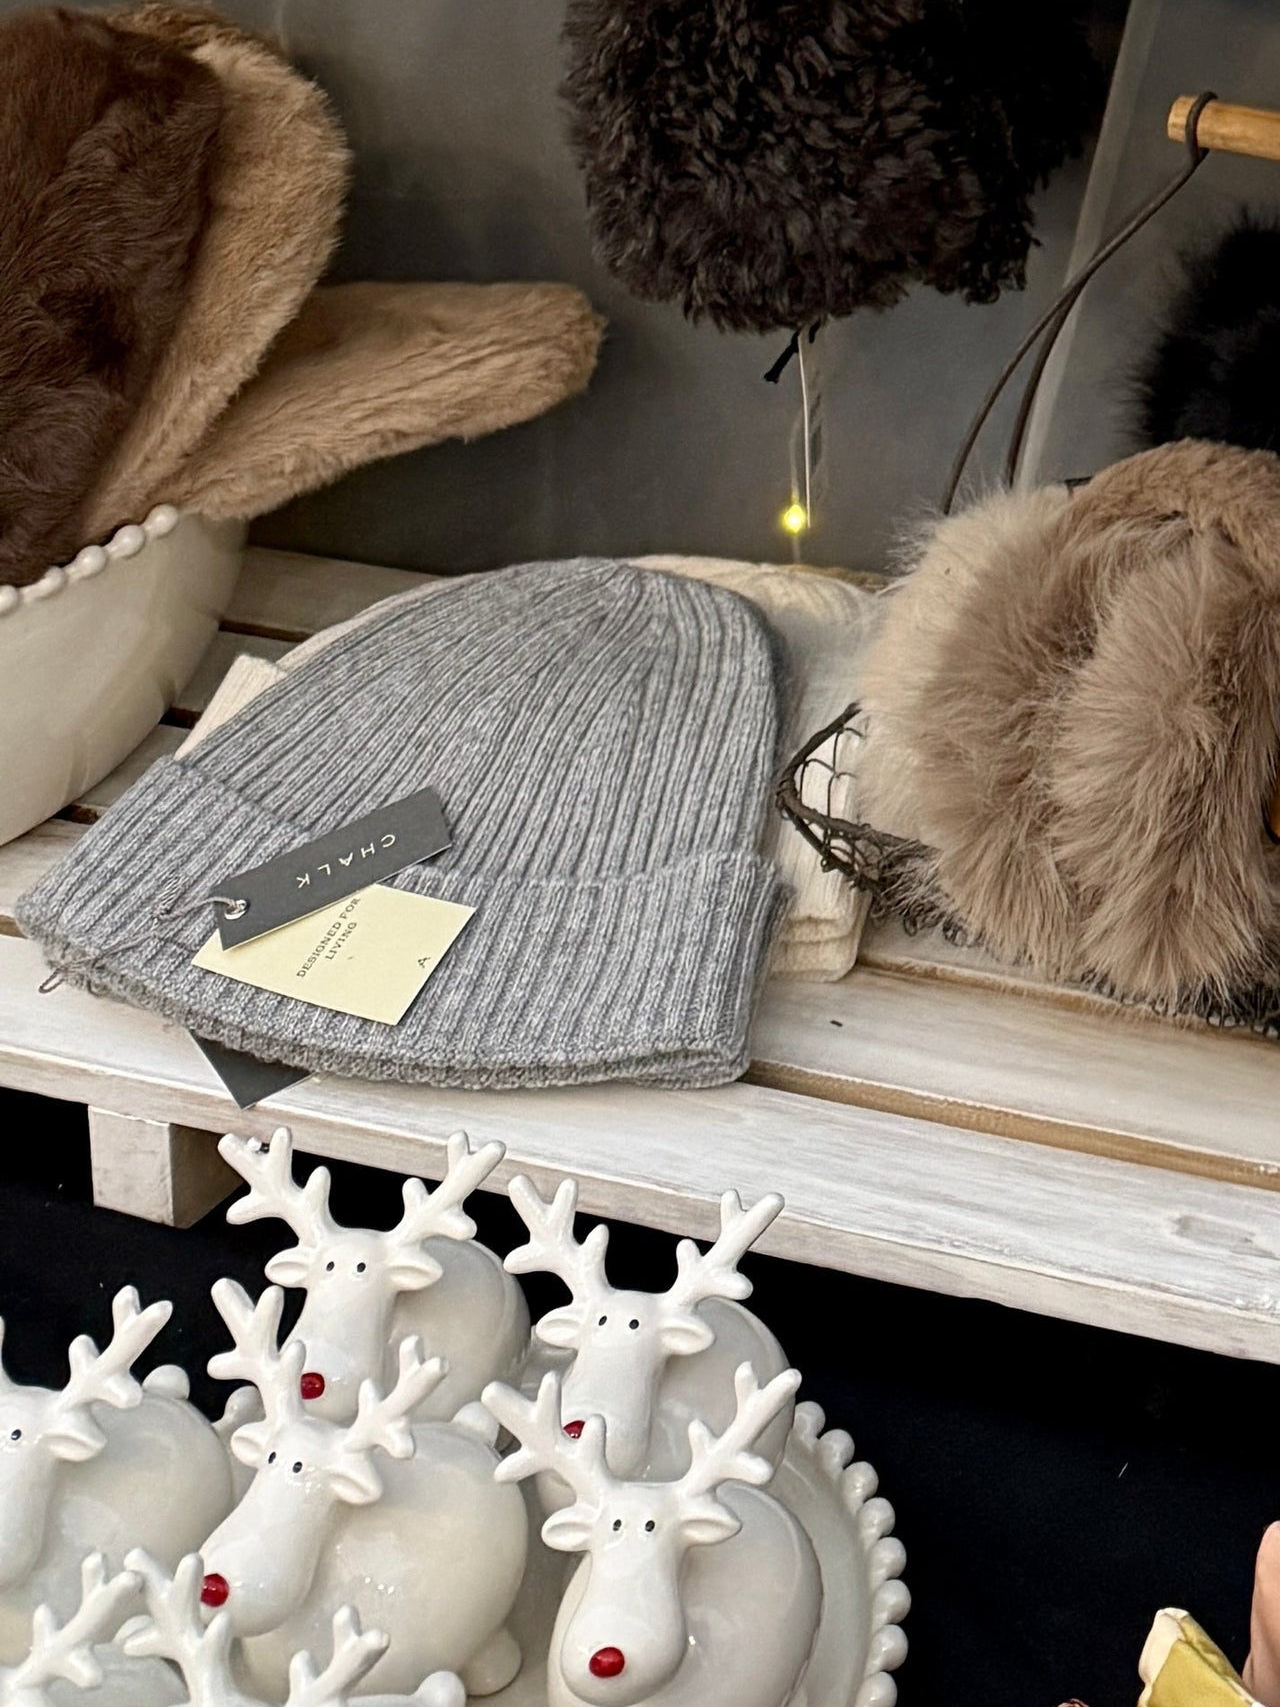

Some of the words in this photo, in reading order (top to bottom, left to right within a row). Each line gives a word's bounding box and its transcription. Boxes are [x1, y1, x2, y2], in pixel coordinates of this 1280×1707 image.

[296, 834, 396, 889] CHALK
[296, 921, 342, 978] DESIGNED
[340, 897, 361, 920] FOR
[325, 922, 357, 960] LIVING
